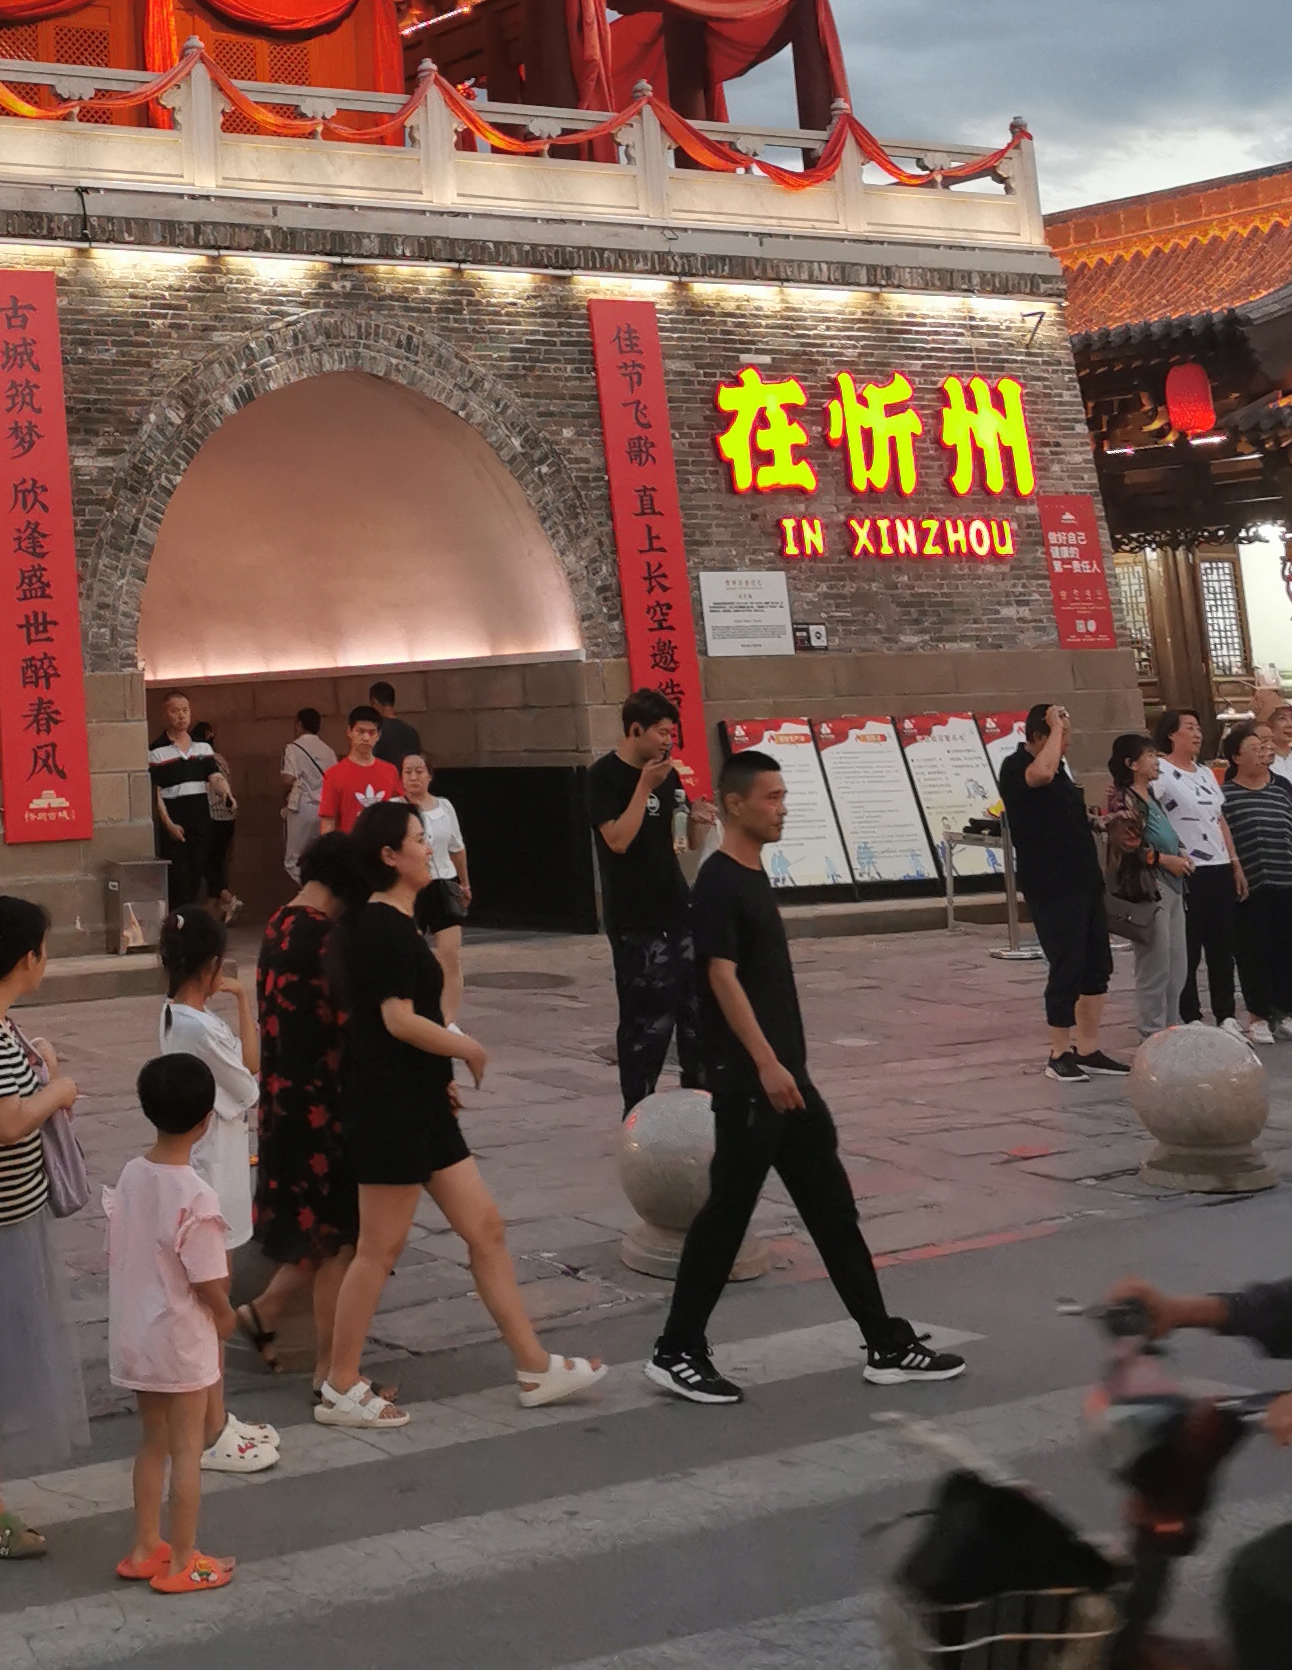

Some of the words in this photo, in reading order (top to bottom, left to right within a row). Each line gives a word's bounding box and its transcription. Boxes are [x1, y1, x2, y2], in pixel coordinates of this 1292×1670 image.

[714, 364, 1037, 498] 在忻州
[780, 516, 825, 557] IN
[848, 516, 1015, 557] XINZHOU
